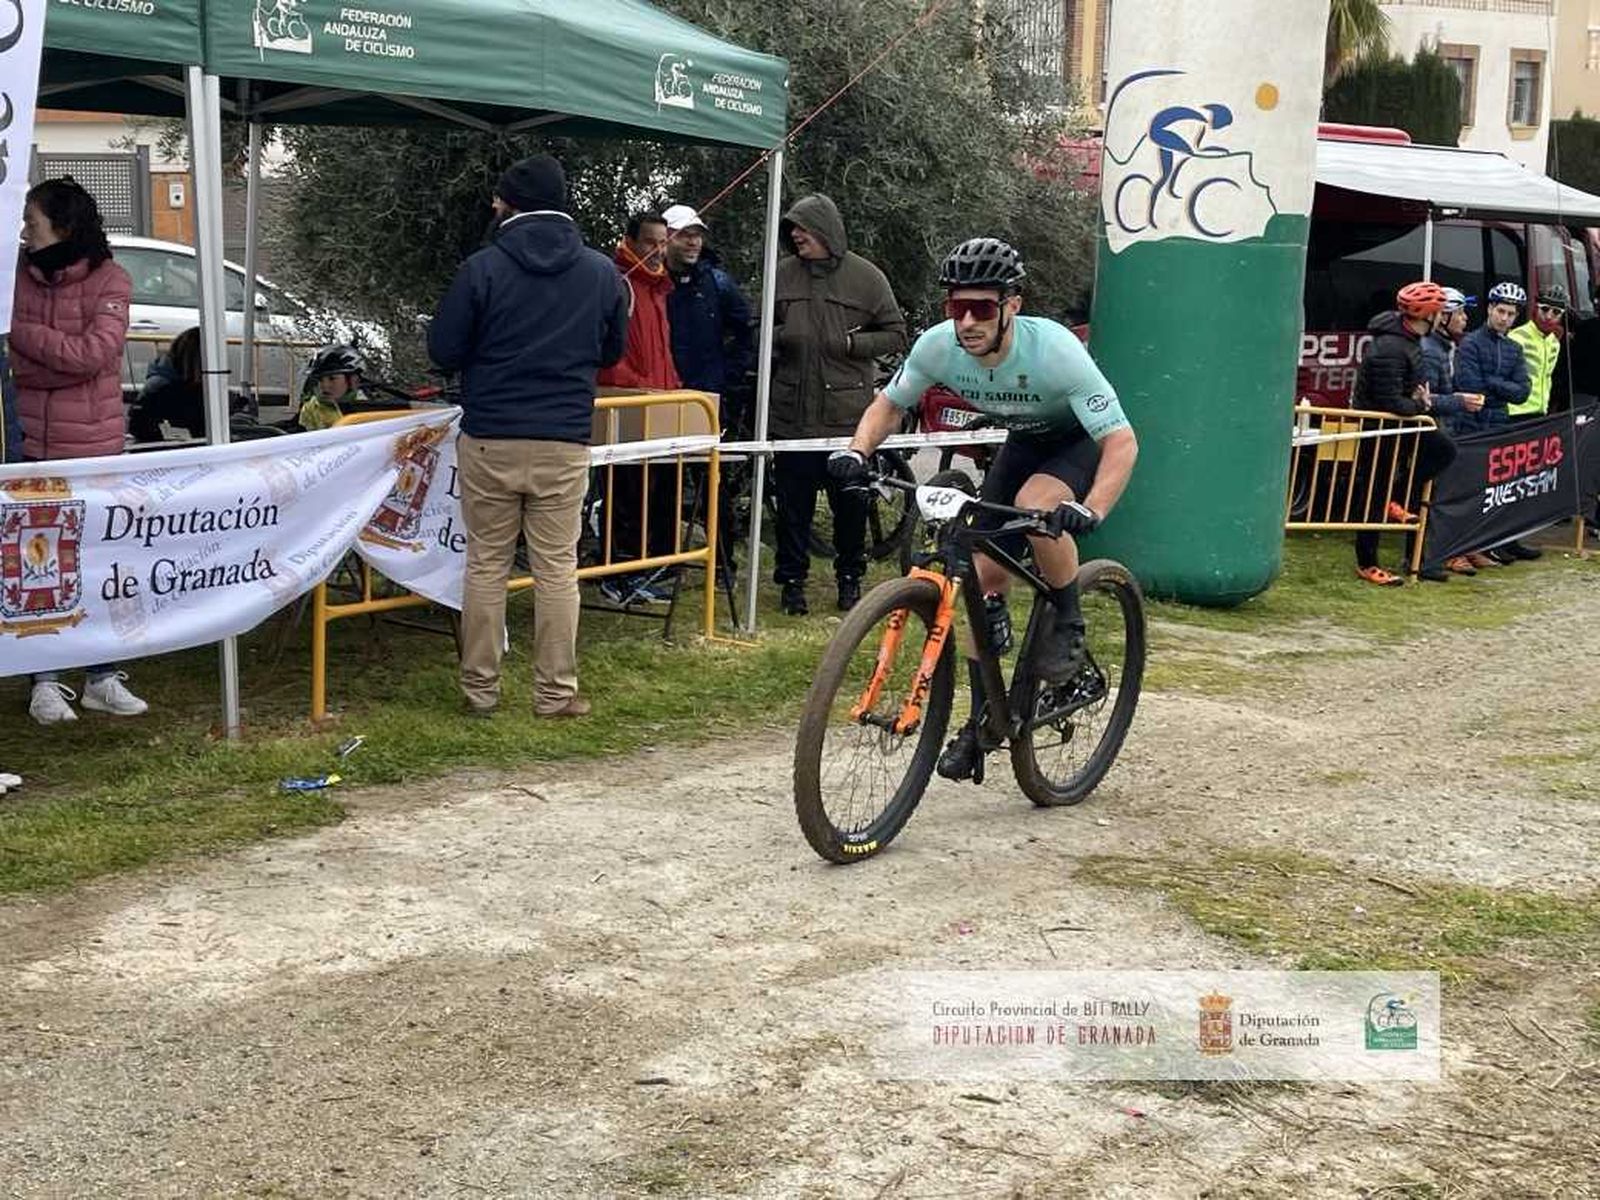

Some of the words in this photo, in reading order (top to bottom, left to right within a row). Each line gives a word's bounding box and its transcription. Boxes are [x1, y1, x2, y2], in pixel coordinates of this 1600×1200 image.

[323, 22, 387, 41] ANDALUZA
[345, 38, 361, 52] DE
[363, 41, 415, 58] CICLISMO
[715, 98, 726, 109] DE
[101, 496, 278, 548] Diputación
[438, 517, 467, 553] de
[102, 562, 139, 601] de
[150, 548, 278, 595] Granada
